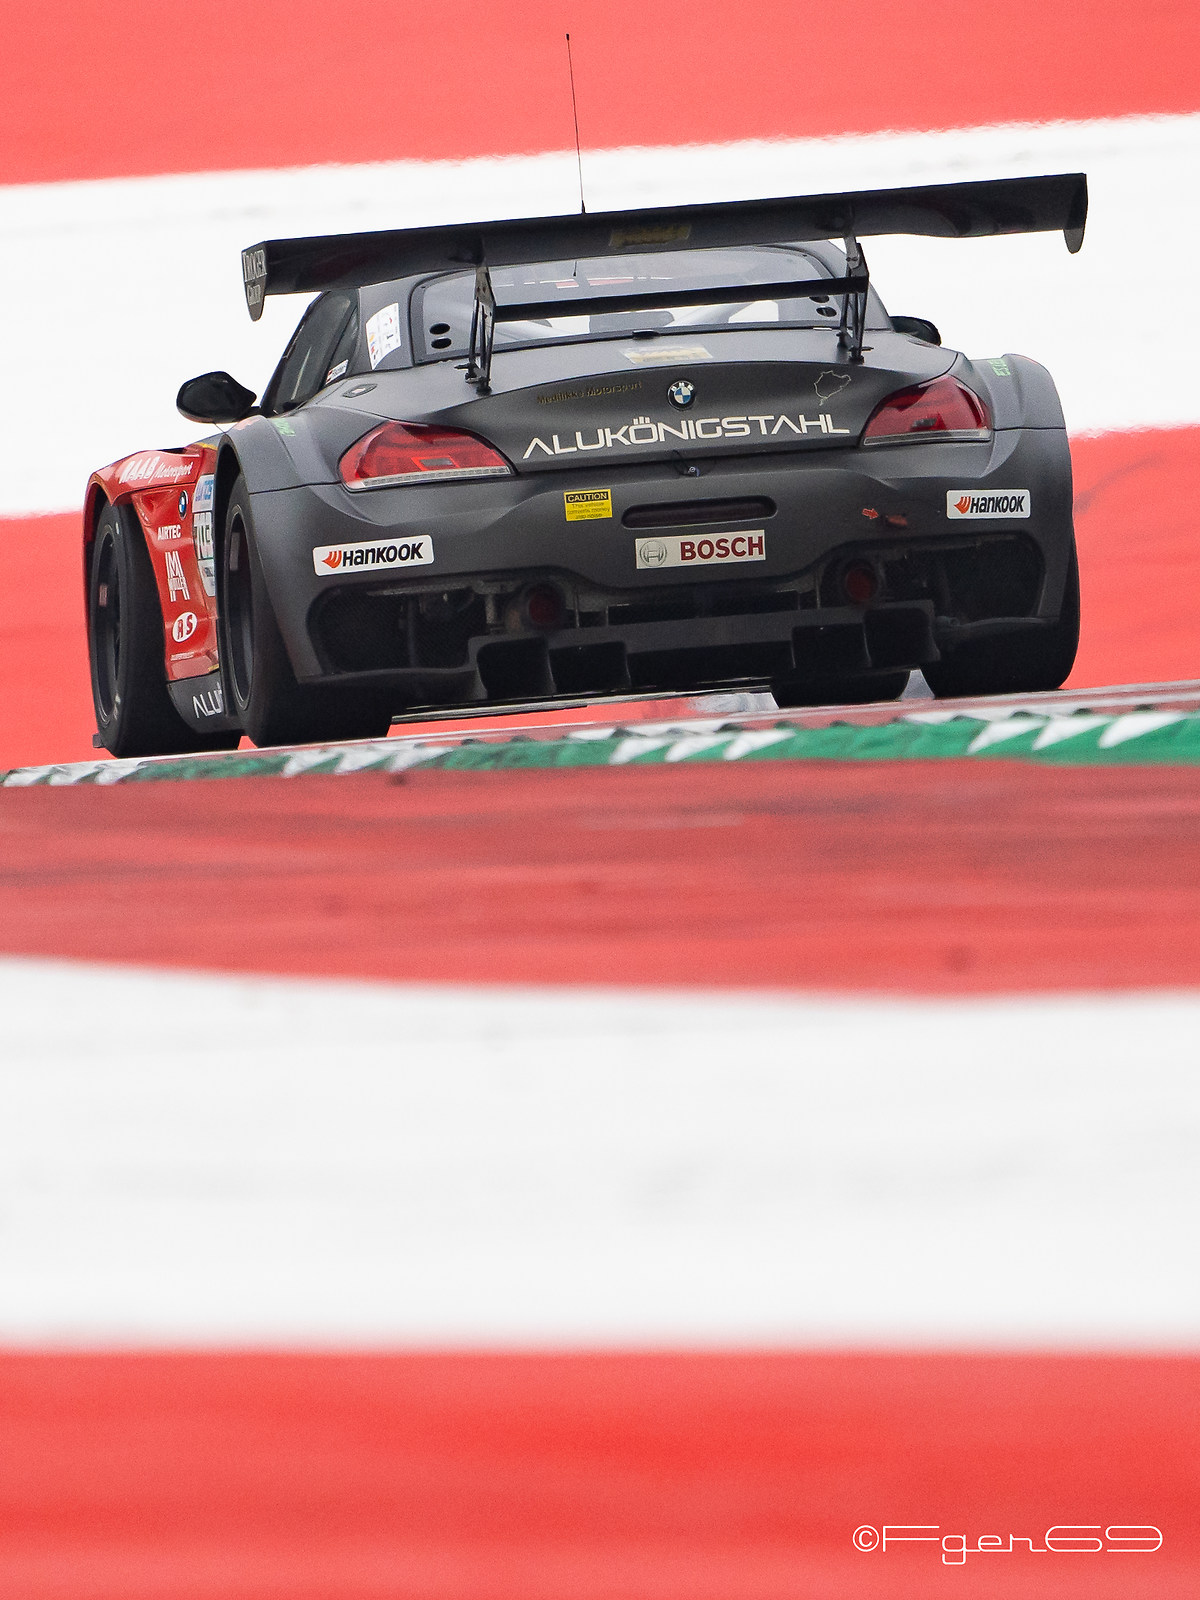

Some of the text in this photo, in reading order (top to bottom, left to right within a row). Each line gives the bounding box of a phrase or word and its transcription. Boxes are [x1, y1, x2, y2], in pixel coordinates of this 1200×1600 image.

[523, 414, 851, 459] ALUKÖNIGSTAHL
[567, 492, 607, 502] CAUTION
[157, 524, 181, 541] AIRTEC
[680, 536, 764, 561] BOSCH
